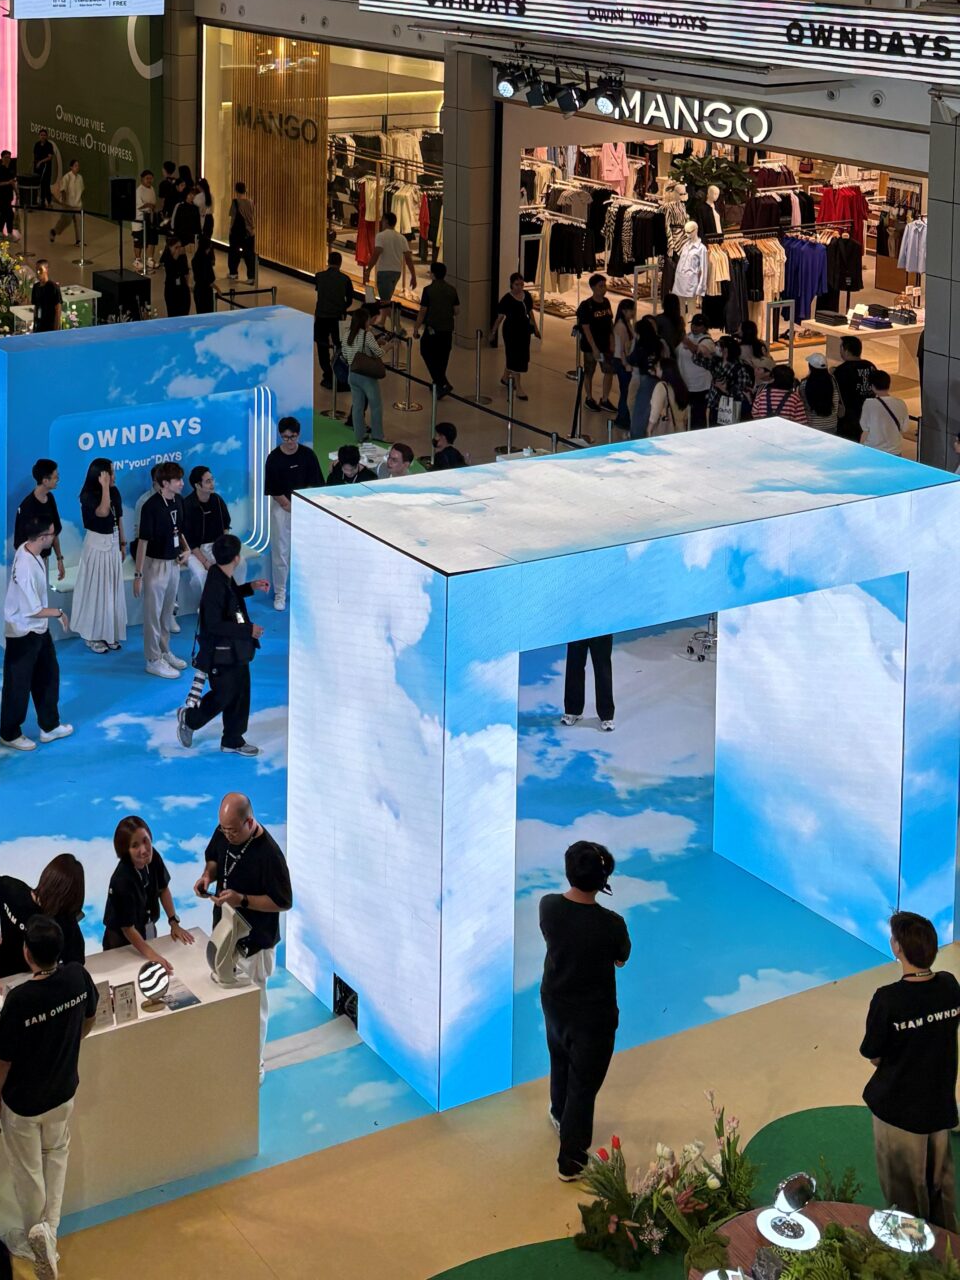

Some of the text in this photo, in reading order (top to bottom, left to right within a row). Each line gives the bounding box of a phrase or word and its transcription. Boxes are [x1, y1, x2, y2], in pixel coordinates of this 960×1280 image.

[587, 7, 623, 23] OWN
[669, 13, 708, 32] DAYS
[785, 21, 952, 61] OWNDAYS
[55, 104, 73, 124] OWN
[74, 114, 90, 128] YOUR
[236, 103, 318, 144] MANGO
[613, 89, 772, 144] MANGO
[80, 132, 97, 150] NOT
[97, 141, 107, 154] TO
[78, 416, 202, 451] OWNDAYS
[24, 1012, 47, 1028] EAM
[50, 991, 88, 1018] OWNDAYS
[893, 1017, 924, 1032] TEAM
